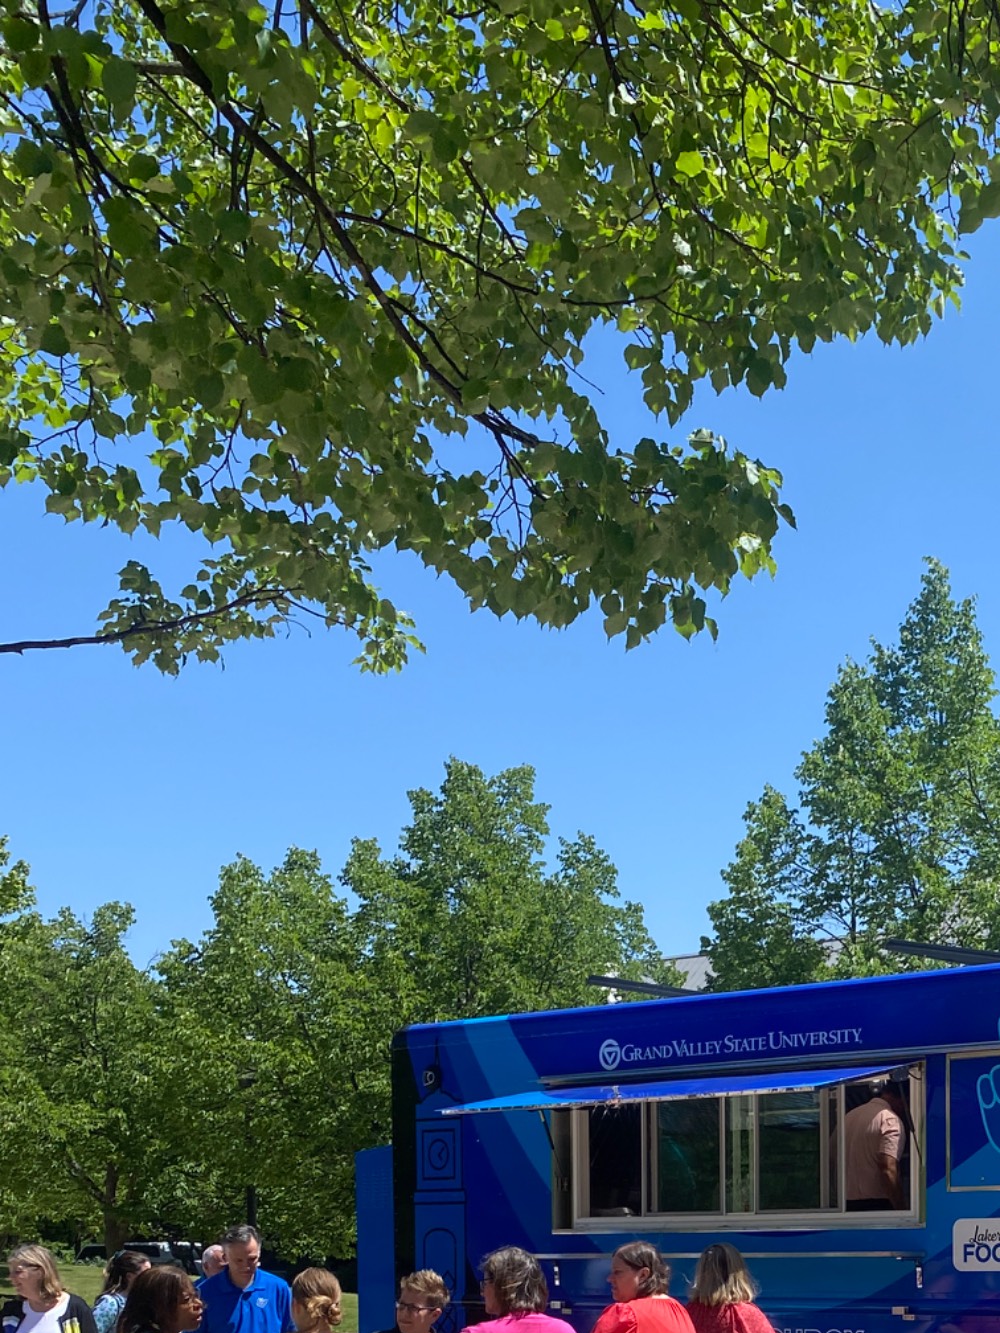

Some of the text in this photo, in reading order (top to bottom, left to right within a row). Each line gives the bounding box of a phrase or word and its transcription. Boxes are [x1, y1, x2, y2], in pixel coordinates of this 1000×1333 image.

[621, 1027, 862, 1062] GRAND VALLEY STATE UNIVERSITY
